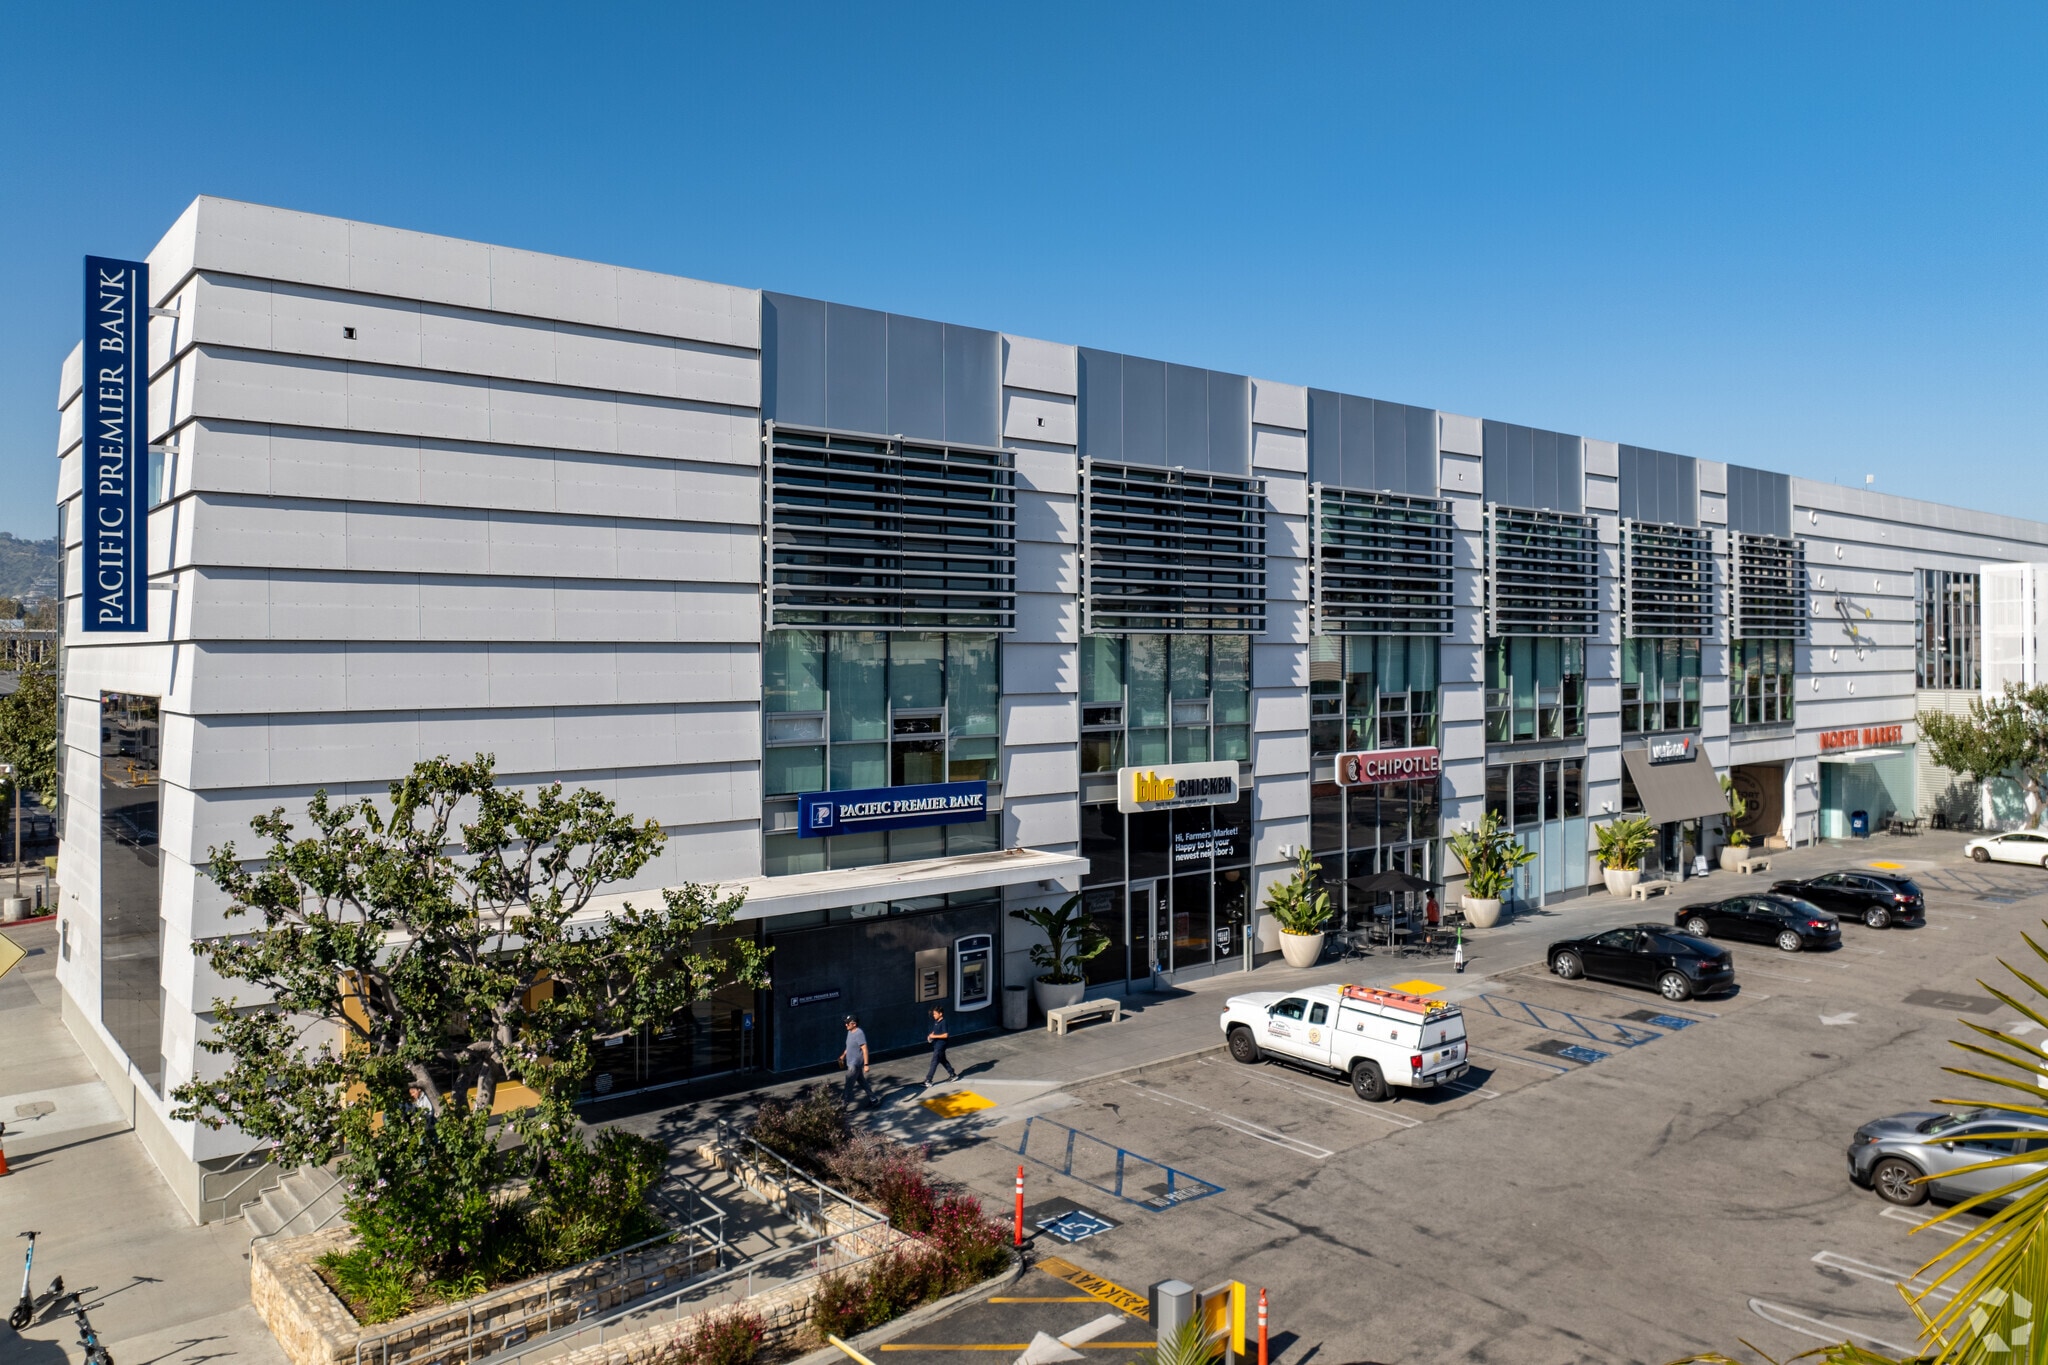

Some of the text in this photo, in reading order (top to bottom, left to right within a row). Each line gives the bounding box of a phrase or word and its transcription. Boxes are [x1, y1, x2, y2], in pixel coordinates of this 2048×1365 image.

[98, 268, 125, 625] PACIFIC PREMIER BANK
[1819, 720, 1903, 749] NORTH MARKET
[1366, 755, 1438, 777] CHIPOTLE
[1133, 771, 1232, 803] bhc CHICKEN
[839, 793, 983, 818] PACIFIC PREMIER BANK
[1175, 826, 1239, 842] Hi, Farmers Market!
[1175, 843, 1196, 853] Happy
[1197, 841, 1205, 849] to
[1214, 839, 1230, 849] your
[1175, 850, 1200, 862] newest
[1061, 1270, 1150, 1316] WALKWAY
